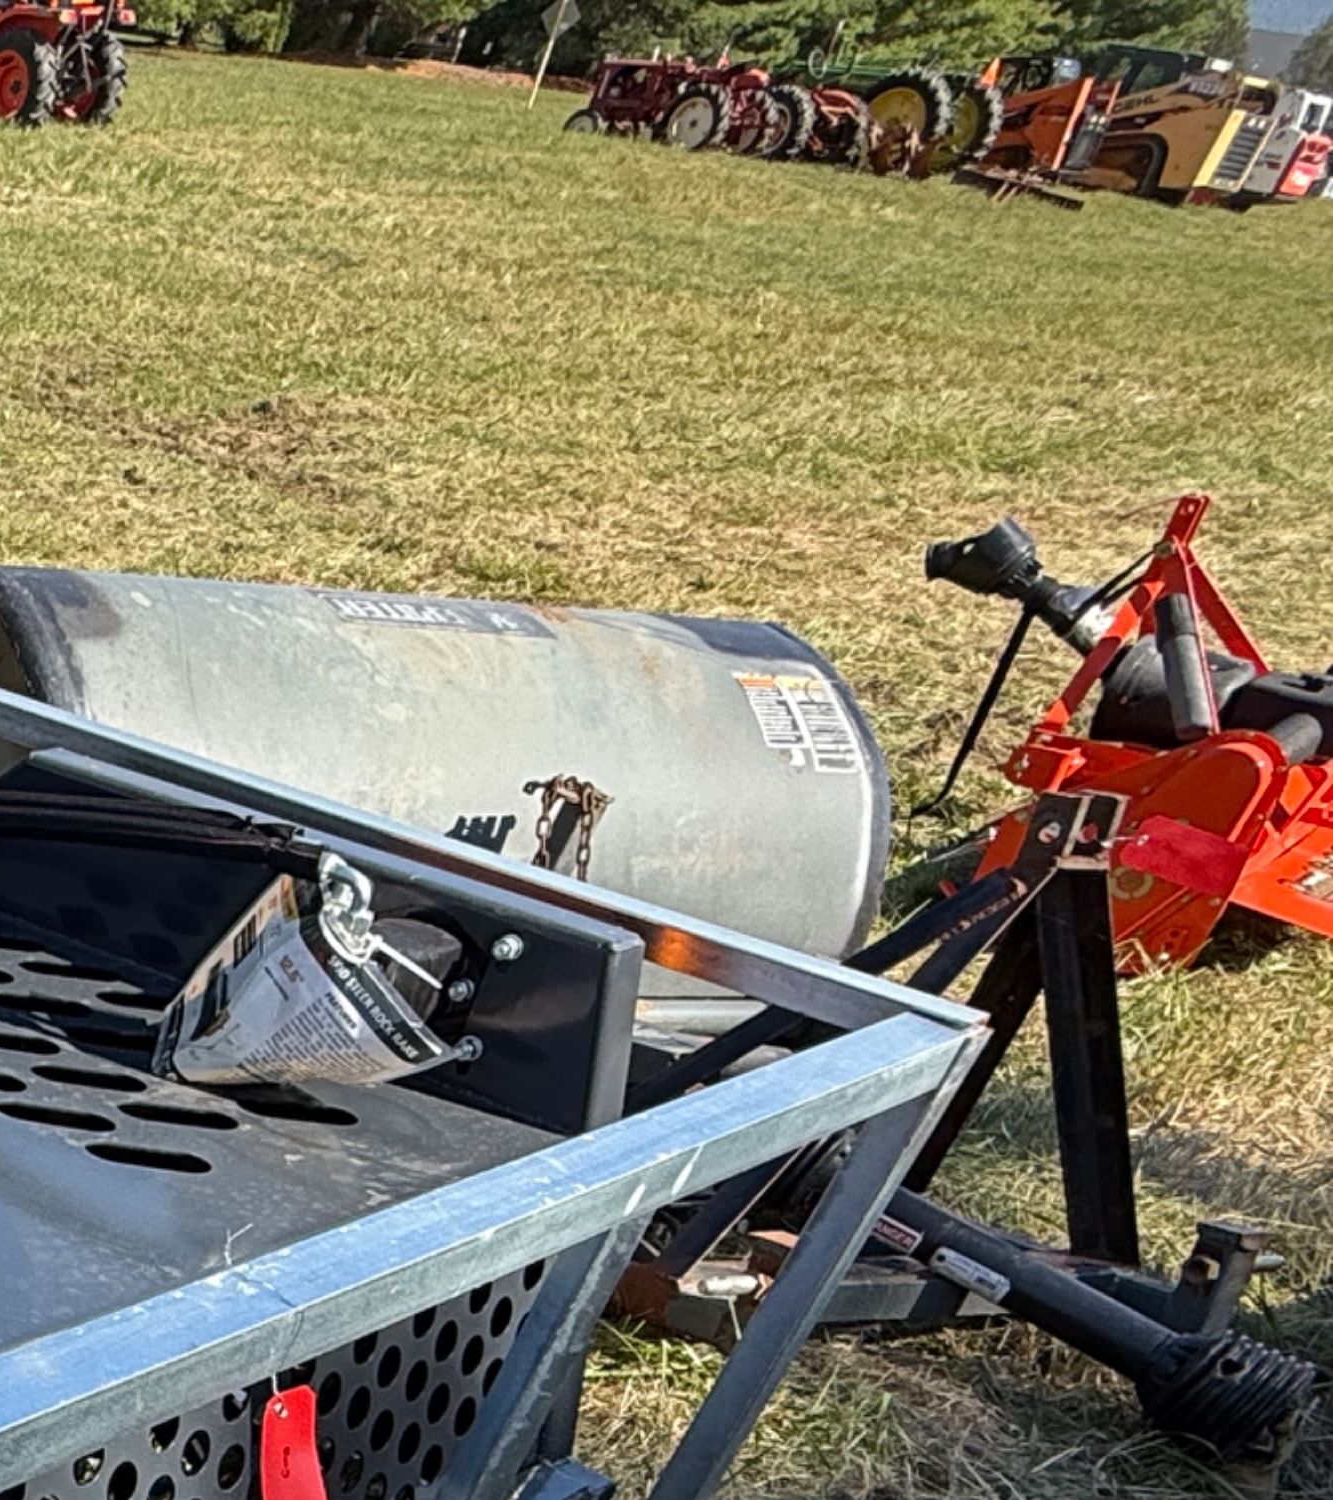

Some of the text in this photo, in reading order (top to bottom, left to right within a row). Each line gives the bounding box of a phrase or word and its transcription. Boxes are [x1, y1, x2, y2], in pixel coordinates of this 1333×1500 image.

[344, 977, 376, 1010] STEER
[369, 1005, 396, 1037] ROCK
[390, 1031, 420, 1060] RAKE
